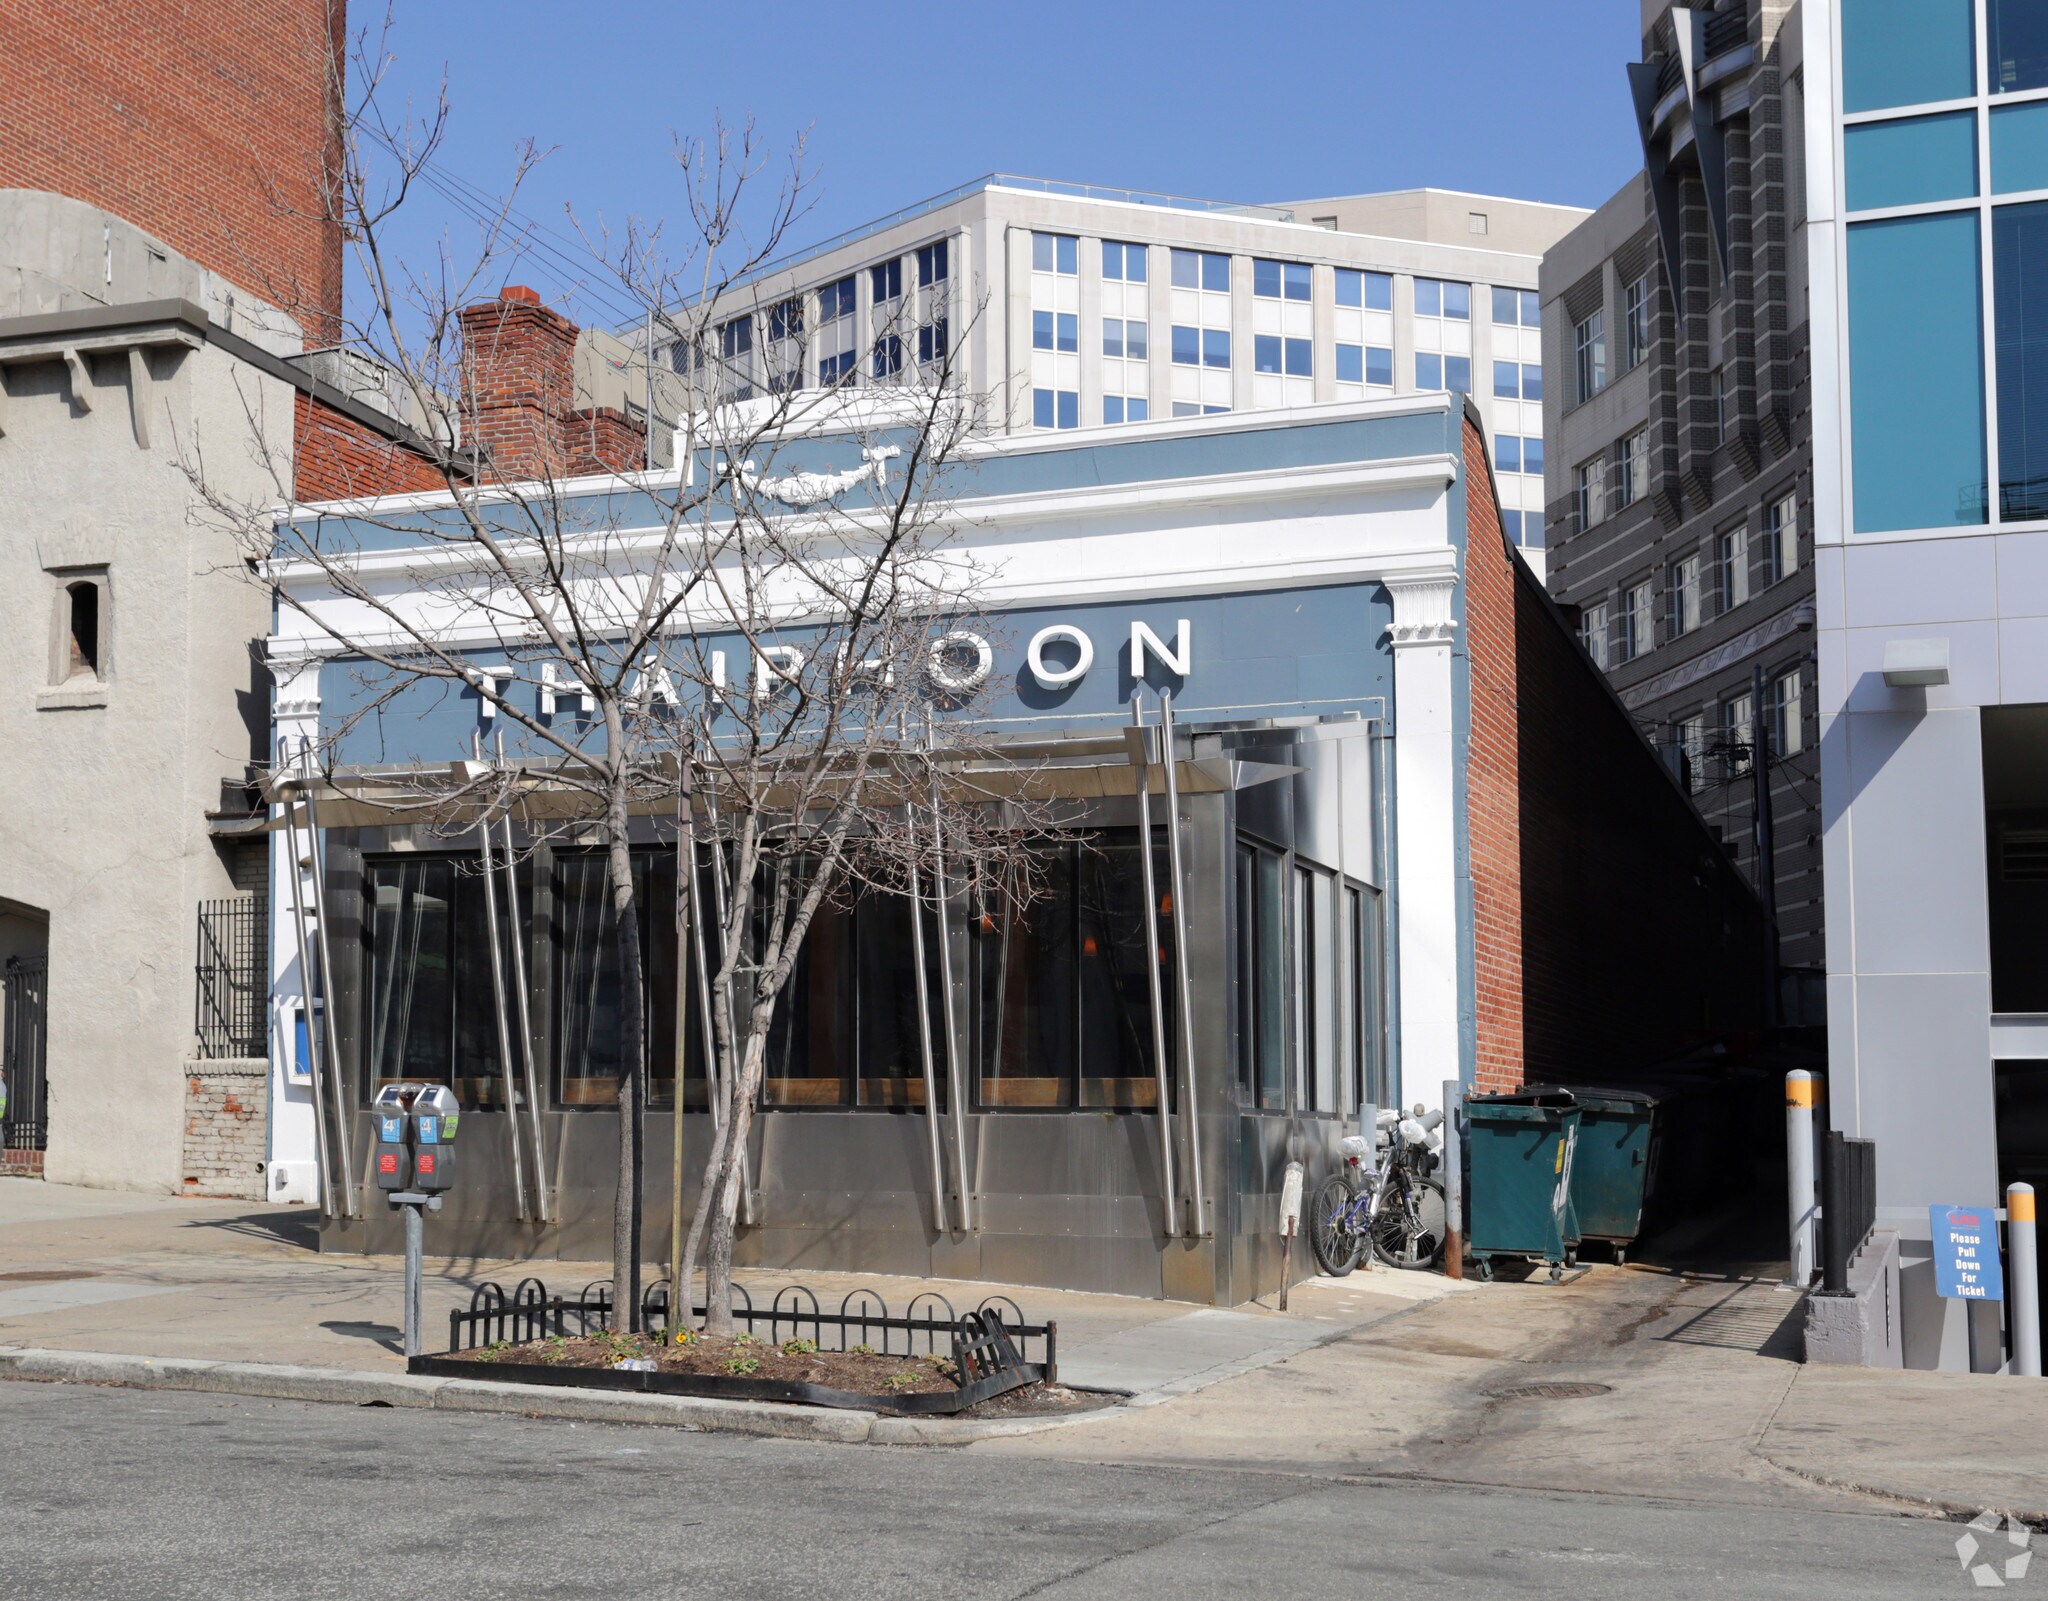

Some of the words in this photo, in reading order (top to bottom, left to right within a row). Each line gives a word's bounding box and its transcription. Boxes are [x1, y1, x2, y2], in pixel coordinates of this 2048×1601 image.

[1950, 1233, 1980, 1244] Please
[1958, 1247, 1975, 1257] Pull
[1955, 1259, 1980, 1270] Down
[1962, 1273, 1976, 1283] For
[1956, 1285, 1985, 1296] Ticket
